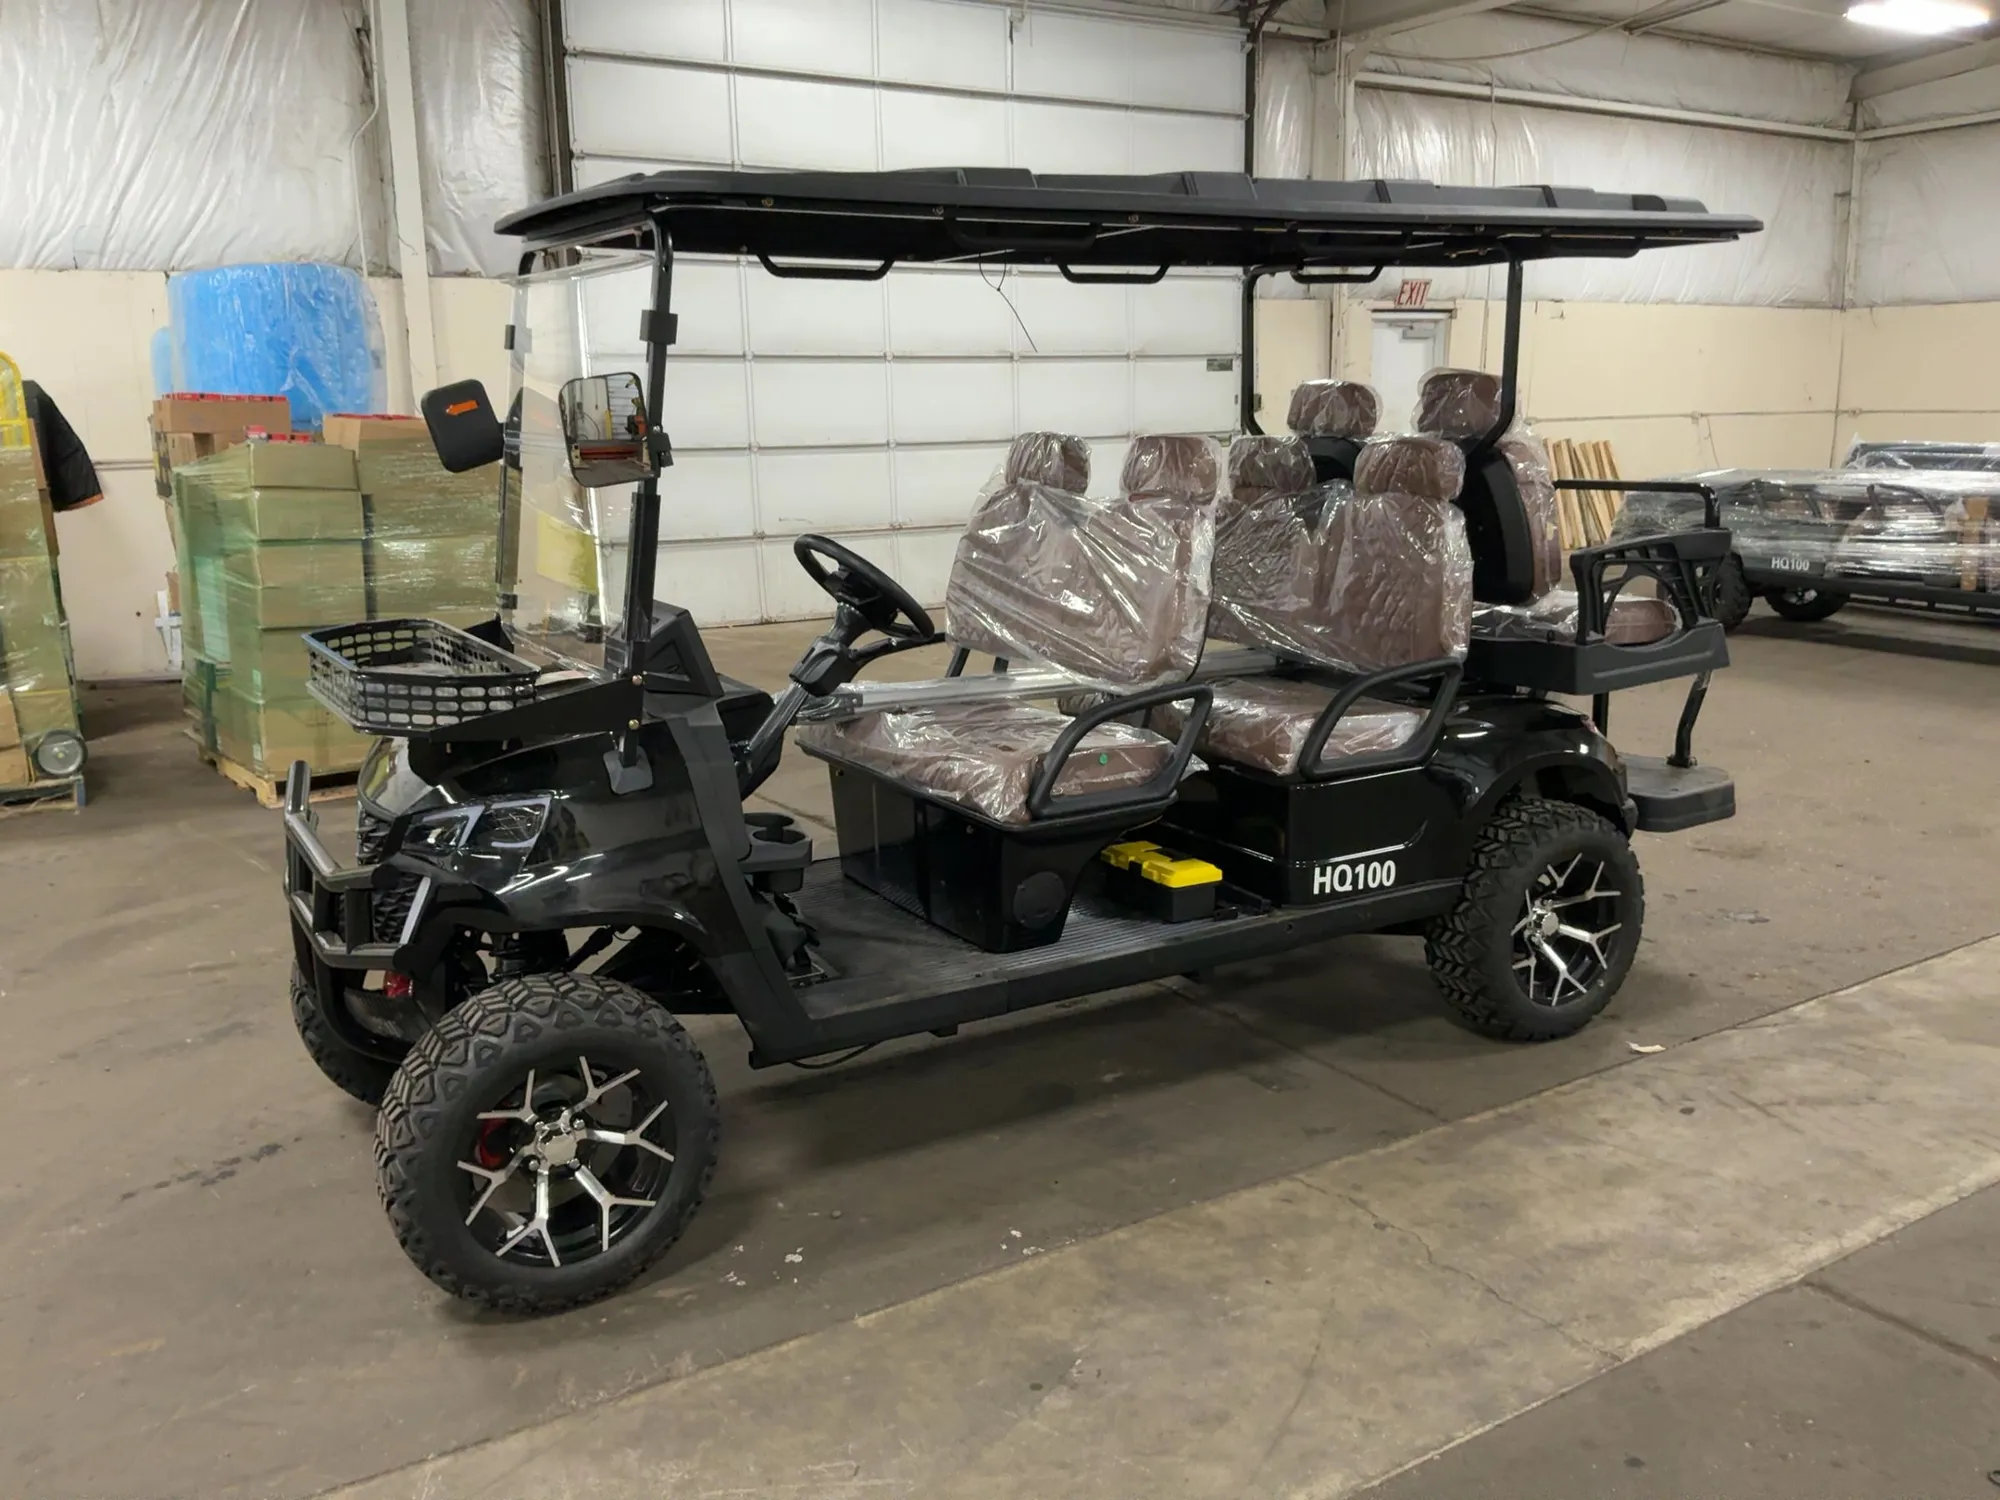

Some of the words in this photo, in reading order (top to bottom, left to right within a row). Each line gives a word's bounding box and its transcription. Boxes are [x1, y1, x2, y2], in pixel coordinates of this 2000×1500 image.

[1397, 281, 1430, 305] EXIT
[1771, 557, 1810, 571] HQ100
[1313, 860, 1396, 895] HQ100
